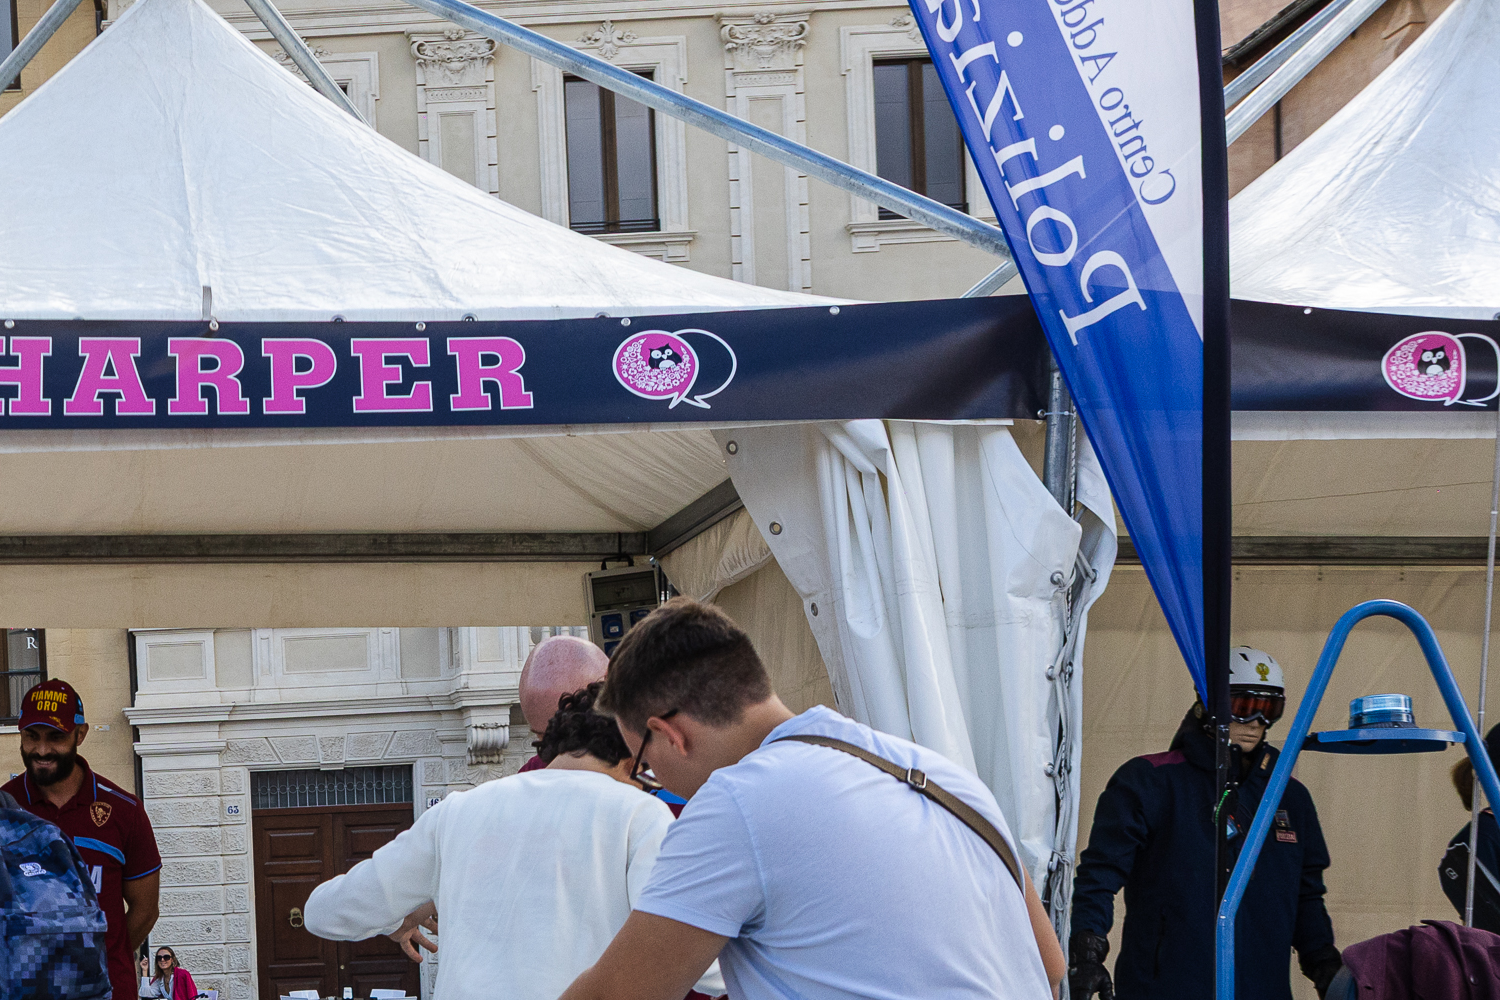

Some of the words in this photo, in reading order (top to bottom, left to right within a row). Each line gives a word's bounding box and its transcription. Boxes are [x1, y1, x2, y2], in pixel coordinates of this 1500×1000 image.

[31, 690, 68, 704] FIAMME
[37, 700, 58, 712] ORO
[227, 805, 240, 814] 63
